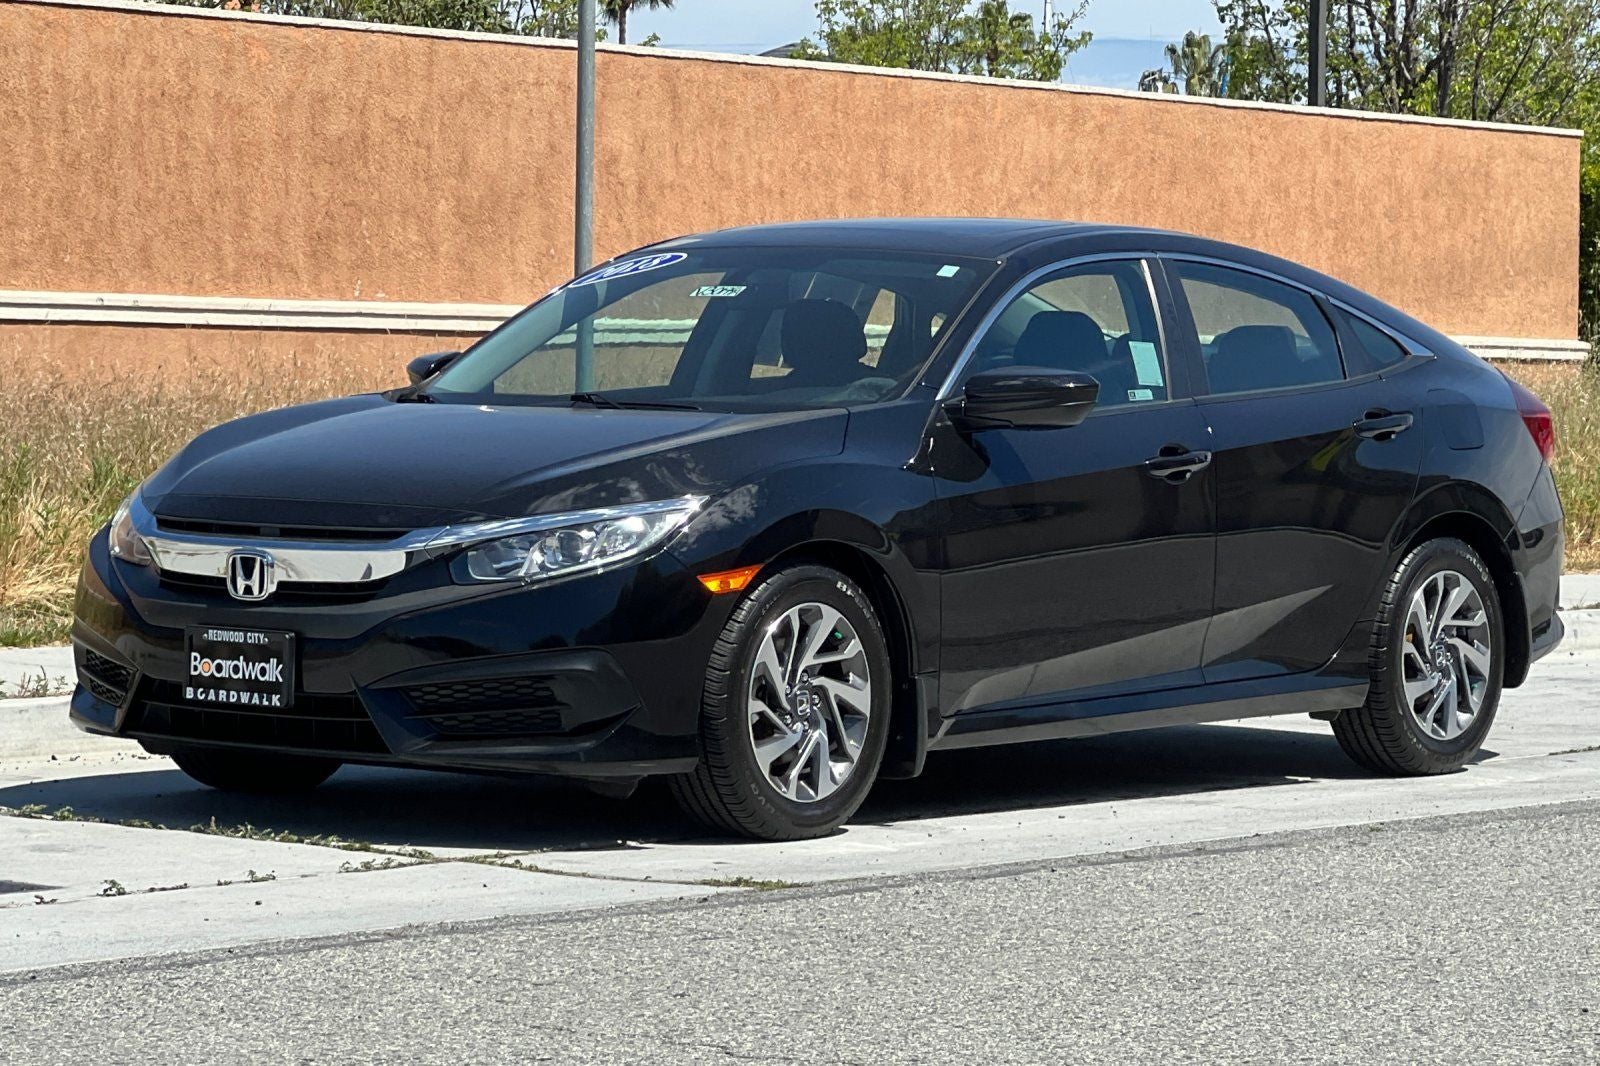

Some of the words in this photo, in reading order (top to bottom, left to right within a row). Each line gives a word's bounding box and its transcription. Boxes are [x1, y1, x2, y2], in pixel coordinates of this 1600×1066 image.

[208, 629, 245, 643] REDWOOD
[247, 632, 265, 644] CITY
[190, 652, 283, 682] Boardwalk
[186, 687, 281, 706] BOARDWALK
